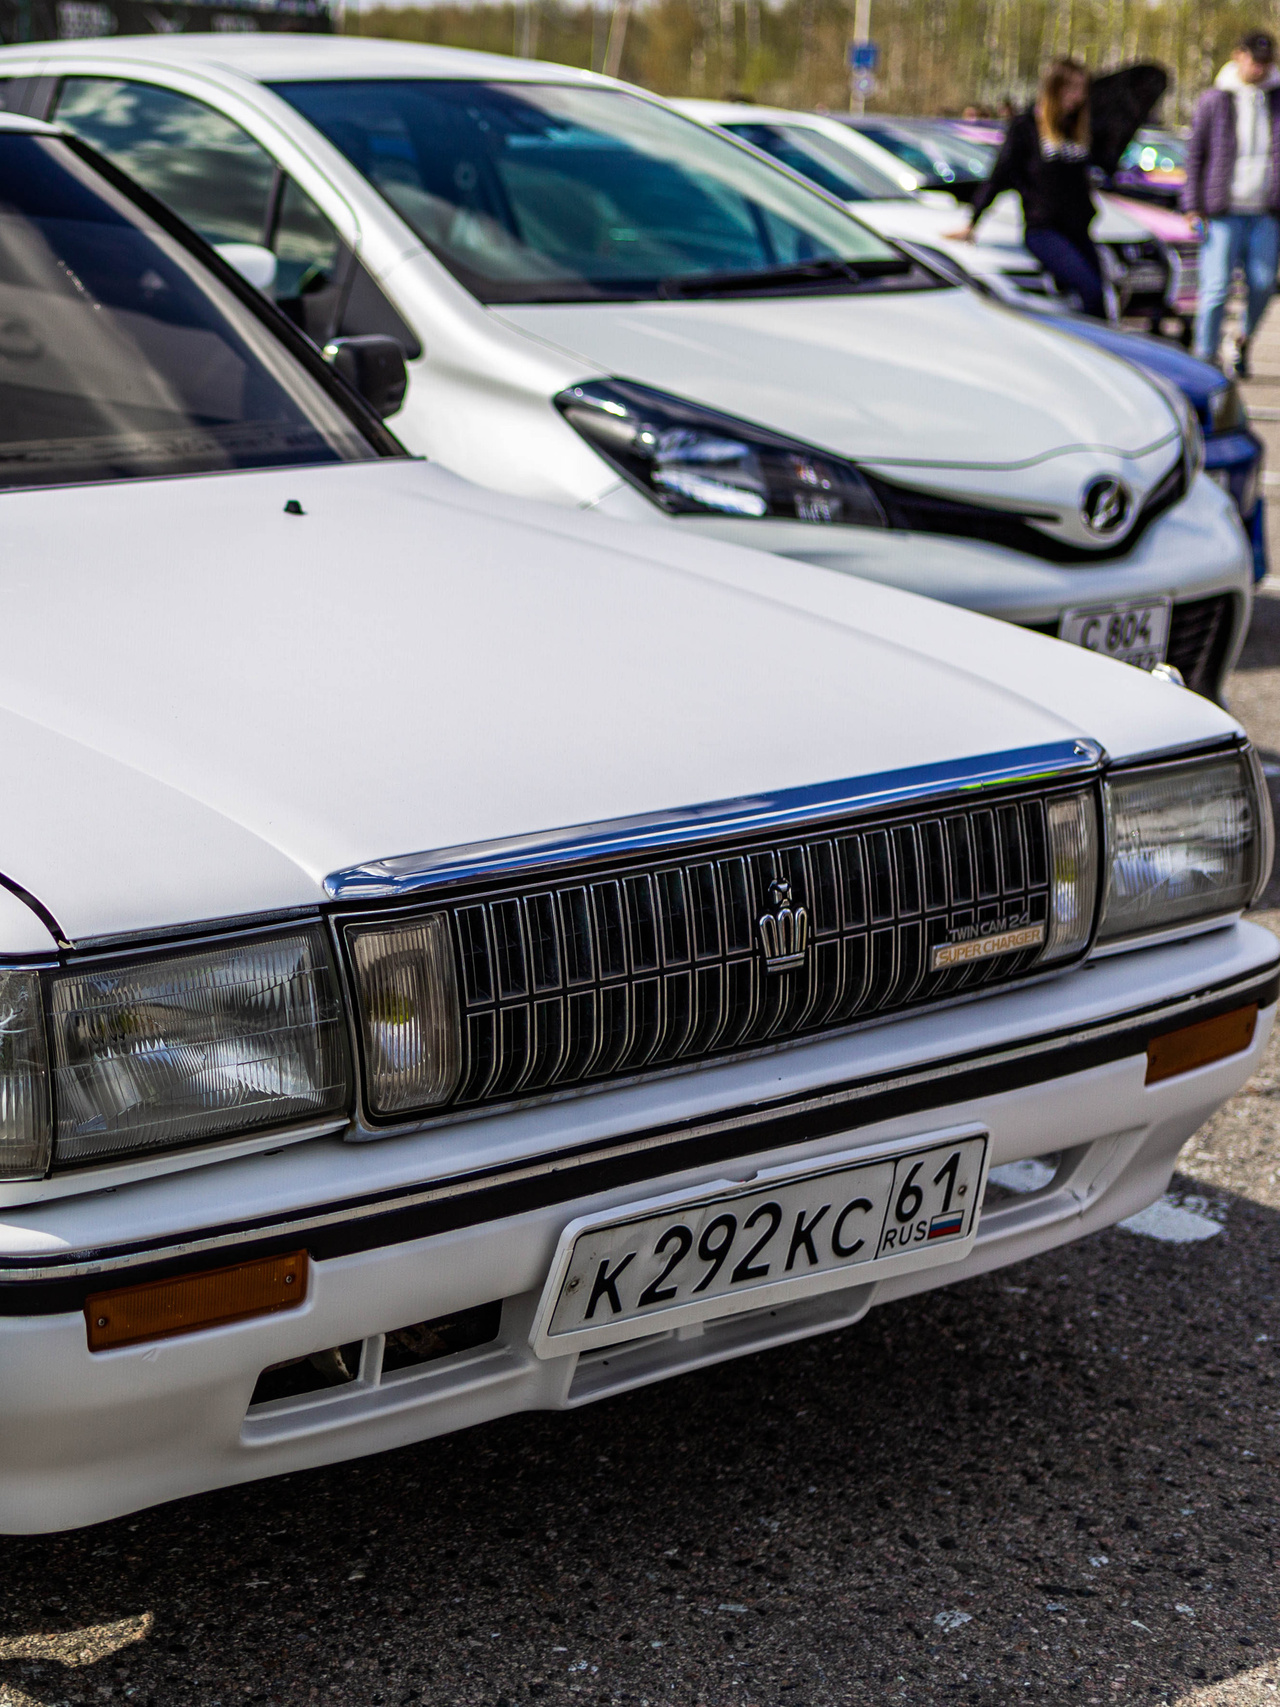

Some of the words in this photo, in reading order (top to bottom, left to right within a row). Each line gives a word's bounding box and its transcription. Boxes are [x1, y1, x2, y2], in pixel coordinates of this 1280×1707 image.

[949, 924, 979, 942] TWIN
[980, 918, 1007, 935] CAM
[1008, 911, 1031, 929] 24
[939, 943, 981, 963] SUPER
[983, 928, 1041, 954] CHARGER
[894, 1150, 961, 1223] 61
[881, 1218, 928, 1252] RUS
